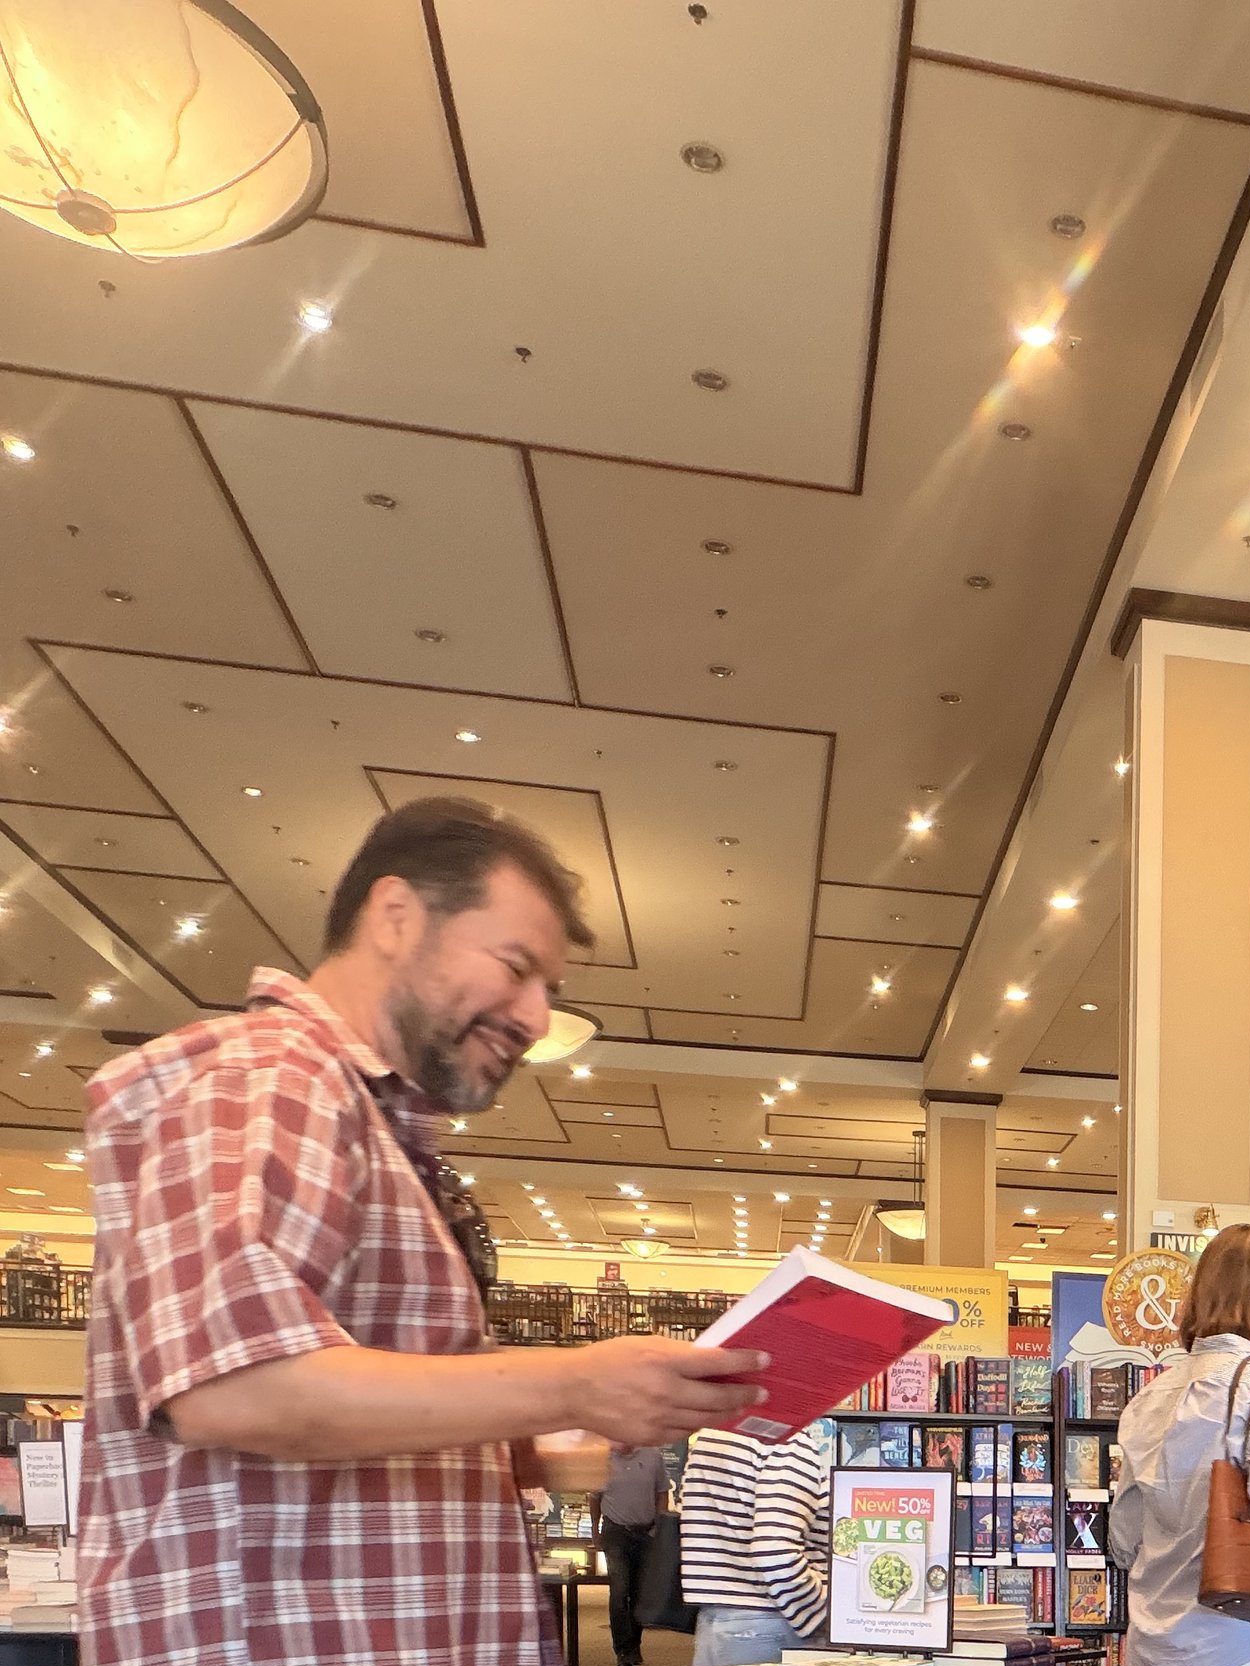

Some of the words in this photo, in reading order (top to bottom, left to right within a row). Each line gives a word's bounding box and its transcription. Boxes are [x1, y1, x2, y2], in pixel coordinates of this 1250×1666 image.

[1135, 1260, 1176, 1272] BOOKS
[1114, 1267, 1134, 1300] MORE
[946, 1287, 991, 1295] MEMBERS
[960, 1319, 985, 1328] OFF
[1113, 1306, 1132, 1337] READ
[936, 1344, 982, 1352] REWARDS
[1015, 1342, 1044, 1352] NEW
[854, 1497, 896, 1513] New!
[898, 1497, 931, 1514] 50%
[863, 1520, 923, 1541] VEG
[976, 1533, 1008, 1545] RIZ
